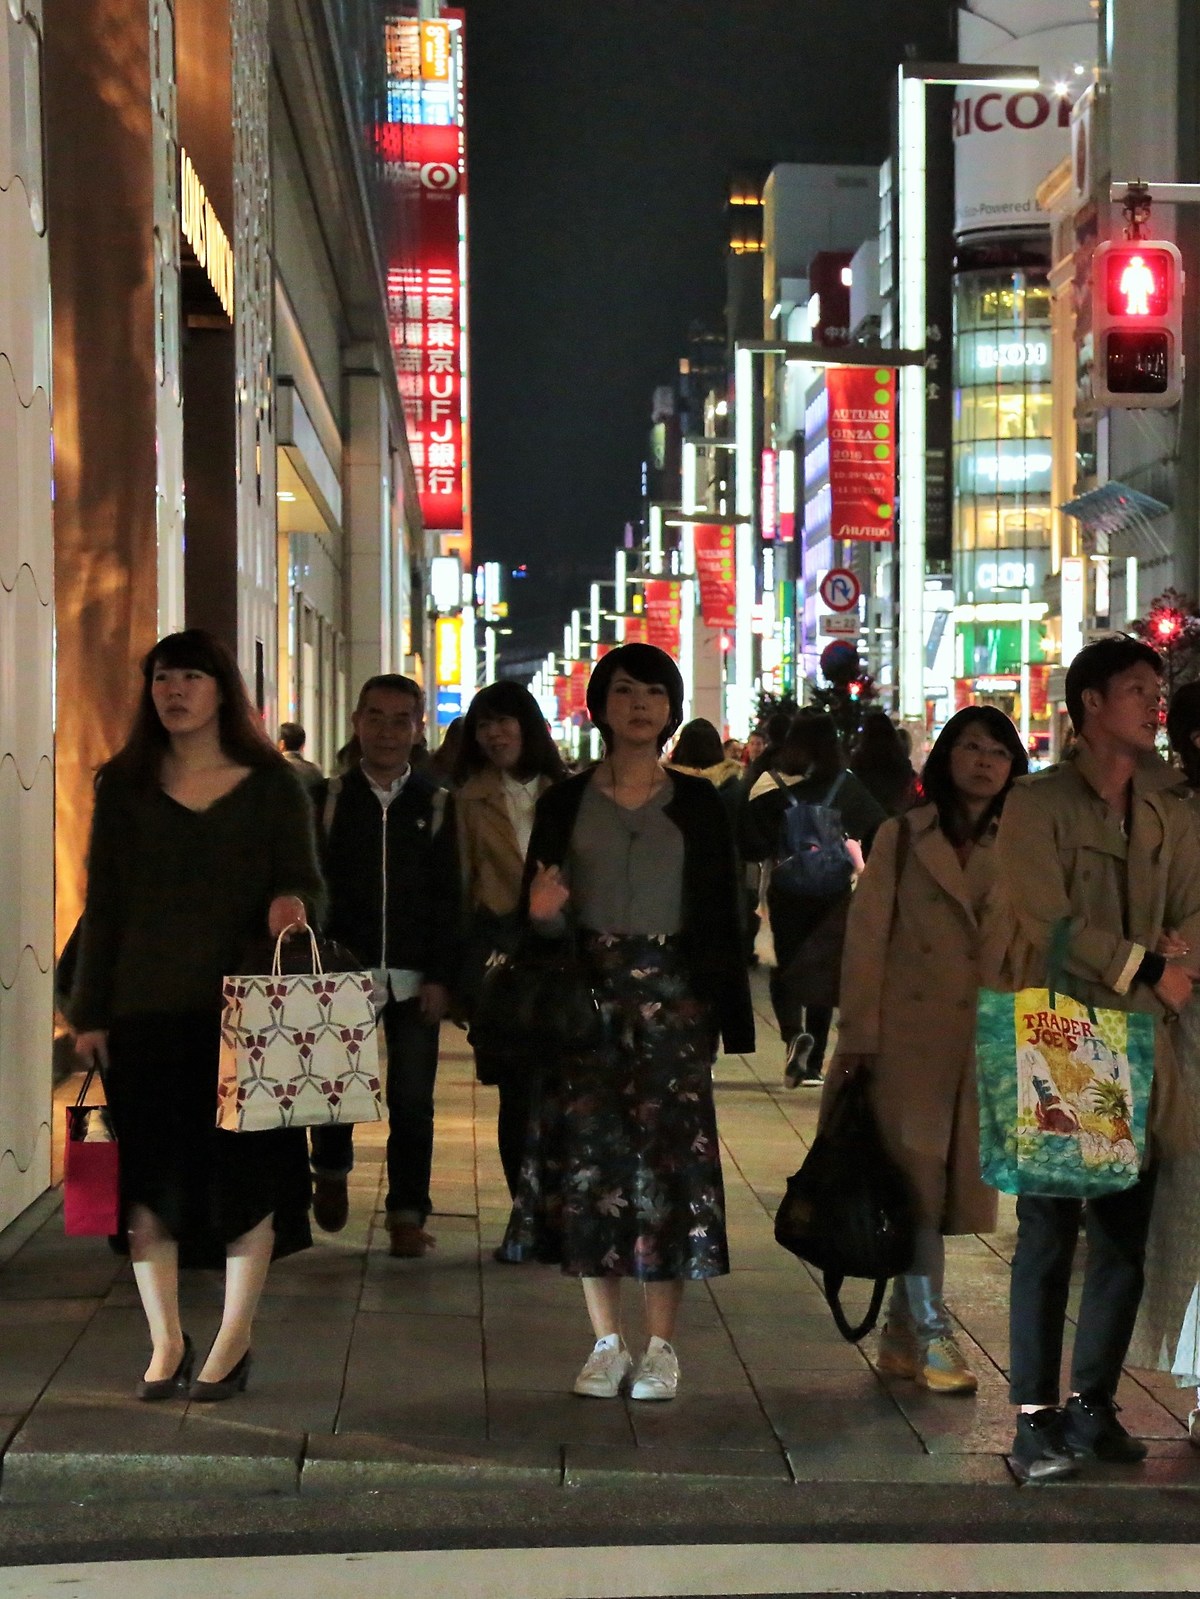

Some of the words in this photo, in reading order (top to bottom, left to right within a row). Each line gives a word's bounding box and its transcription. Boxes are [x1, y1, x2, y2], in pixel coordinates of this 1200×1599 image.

[426, 268, 456, 494] 三菱東京UFJ銀行
[832, 409, 889, 420] AUTUMN
[832, 429, 873, 440] GINZA
[838, 525, 890, 537] SHISEIDO
[1023, 1011, 1095, 1037] TRADER
[1026, 1028, 1078, 1052] JOE'S
